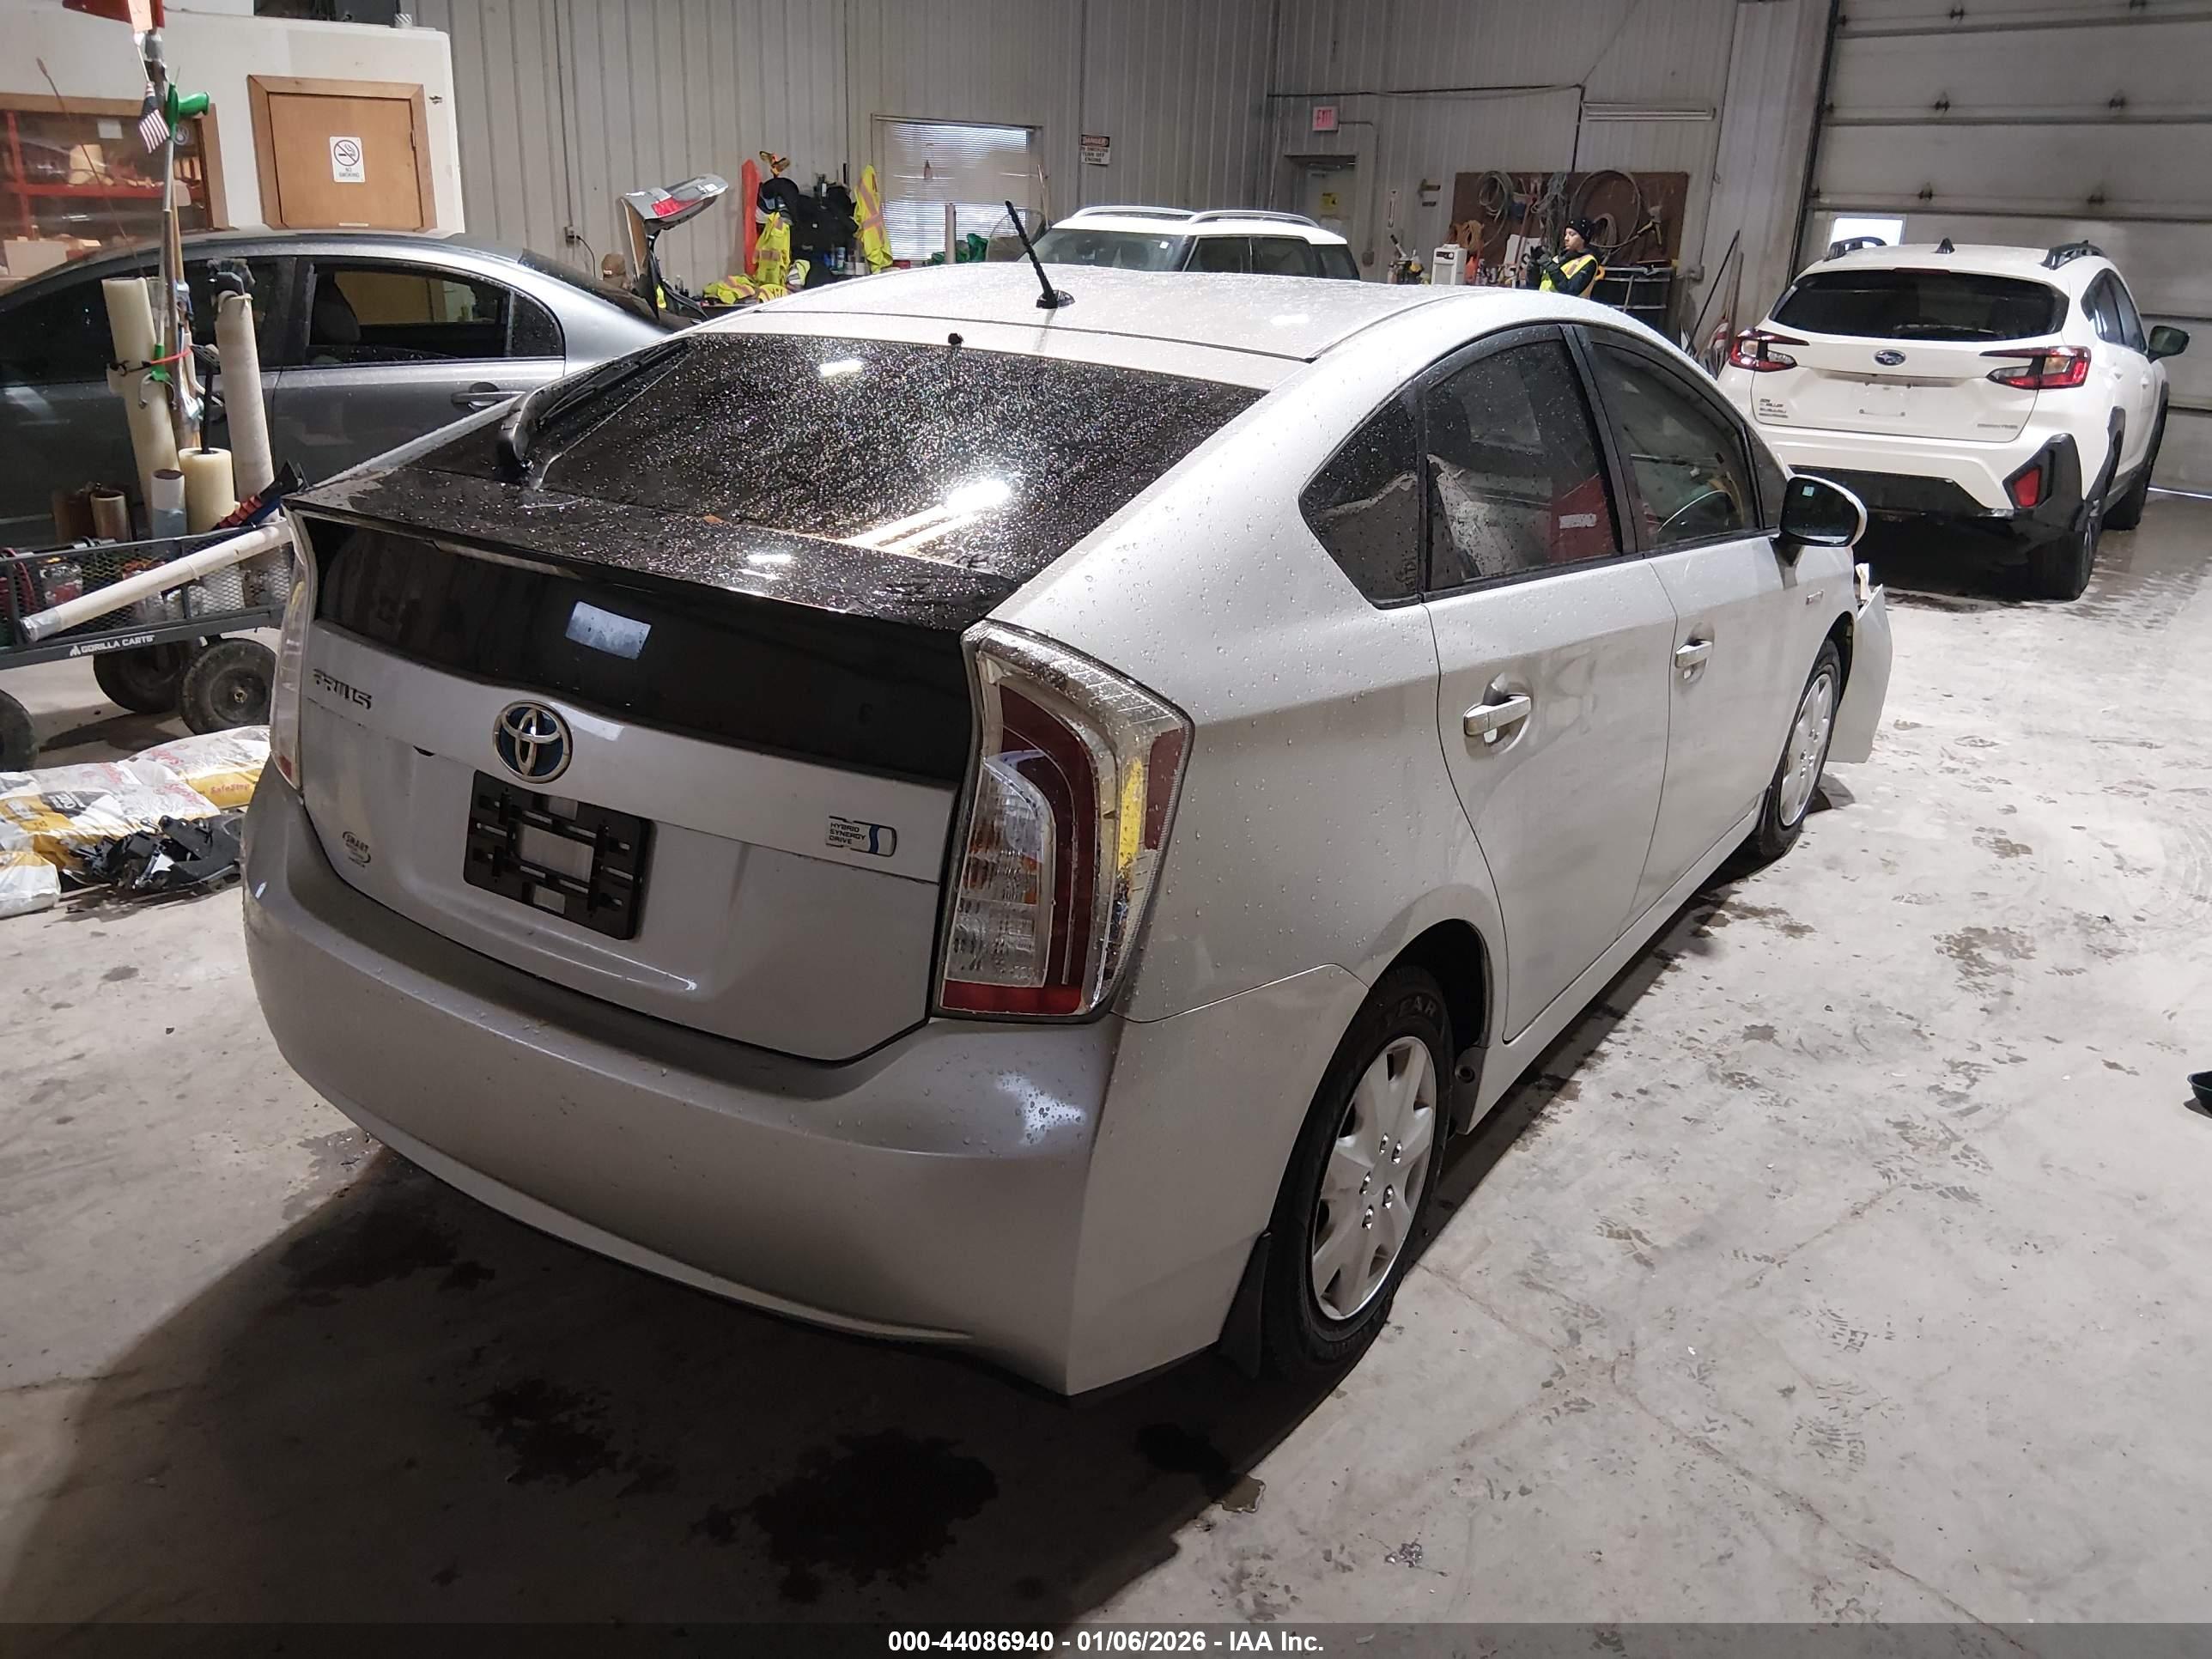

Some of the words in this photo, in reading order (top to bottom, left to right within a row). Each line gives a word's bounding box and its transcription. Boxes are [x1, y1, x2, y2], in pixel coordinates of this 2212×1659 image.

[1085, 137, 1107, 145] DANGER
[81, 640, 120, 653] GORILLA
[122, 635, 153, 647] CARTS
[313, 669, 372, 709] PRIUS
[830, 822, 860, 833] HYBRID
[829, 836, 852, 844] DRIVE
[830, 829, 866, 841] SYNERGY
